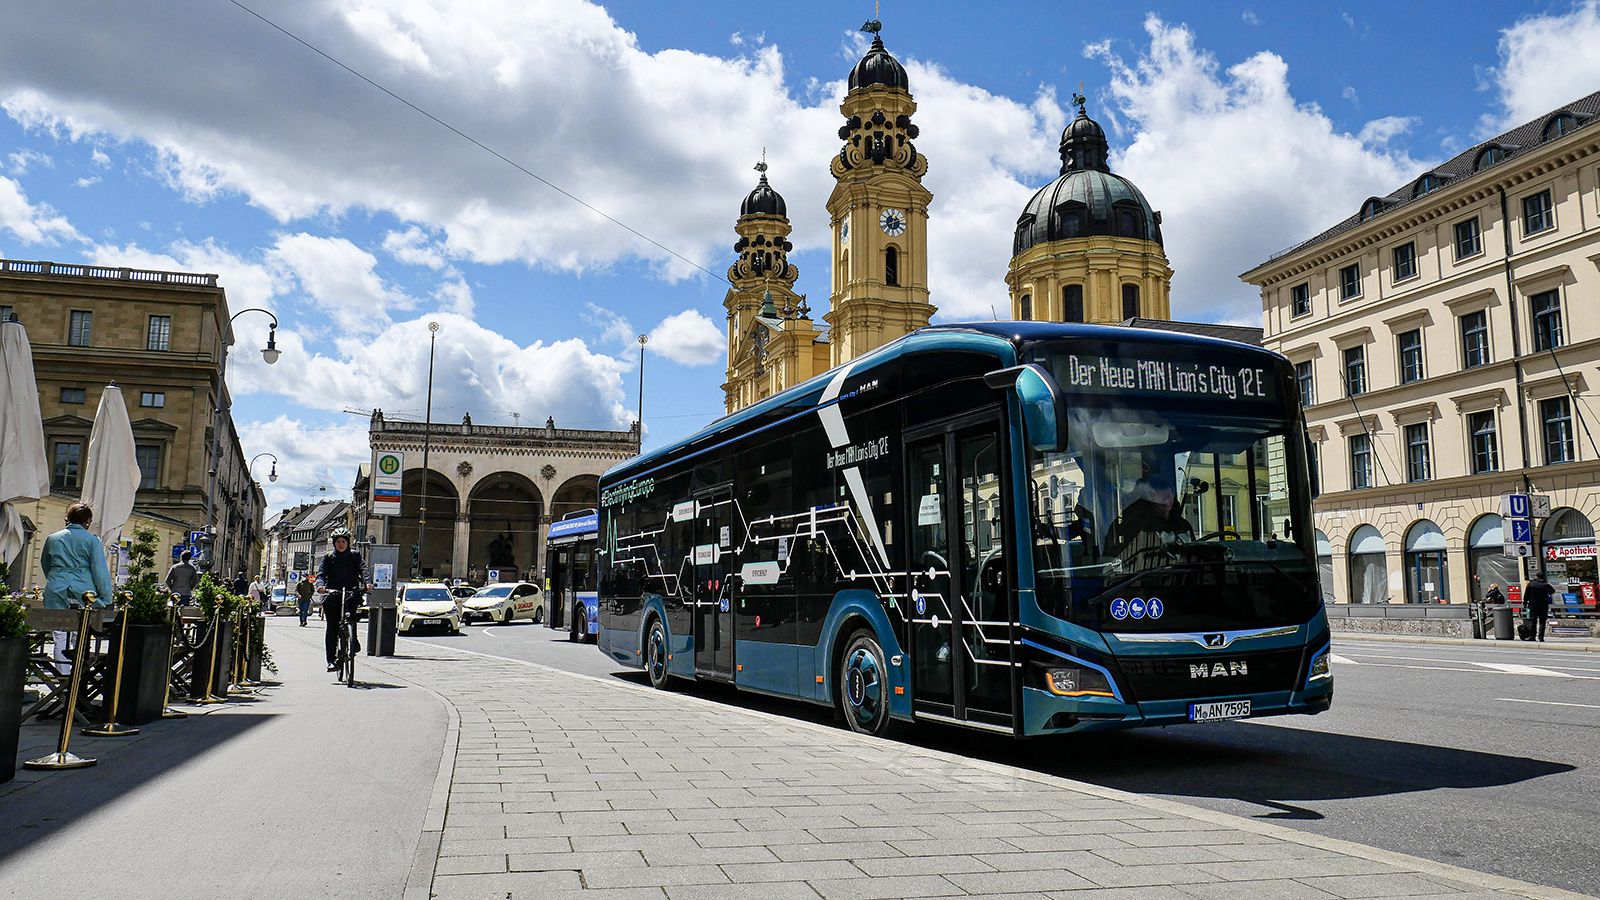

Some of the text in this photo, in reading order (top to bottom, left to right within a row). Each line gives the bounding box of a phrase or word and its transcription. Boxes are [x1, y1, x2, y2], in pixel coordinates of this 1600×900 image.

[1069, 355, 1266, 400] Der Neue MAN Lion's City 12 E
[385, 459, 394, 471] H
[826, 452, 834, 469] Der
[1513, 498, 1524, 514] U
[1560, 545, 1597, 556] Apotheke
[1189, 661, 1248, 678] MAN
[1195, 705, 1202, 719] M
[1225, 702, 1249, 716] 7595
